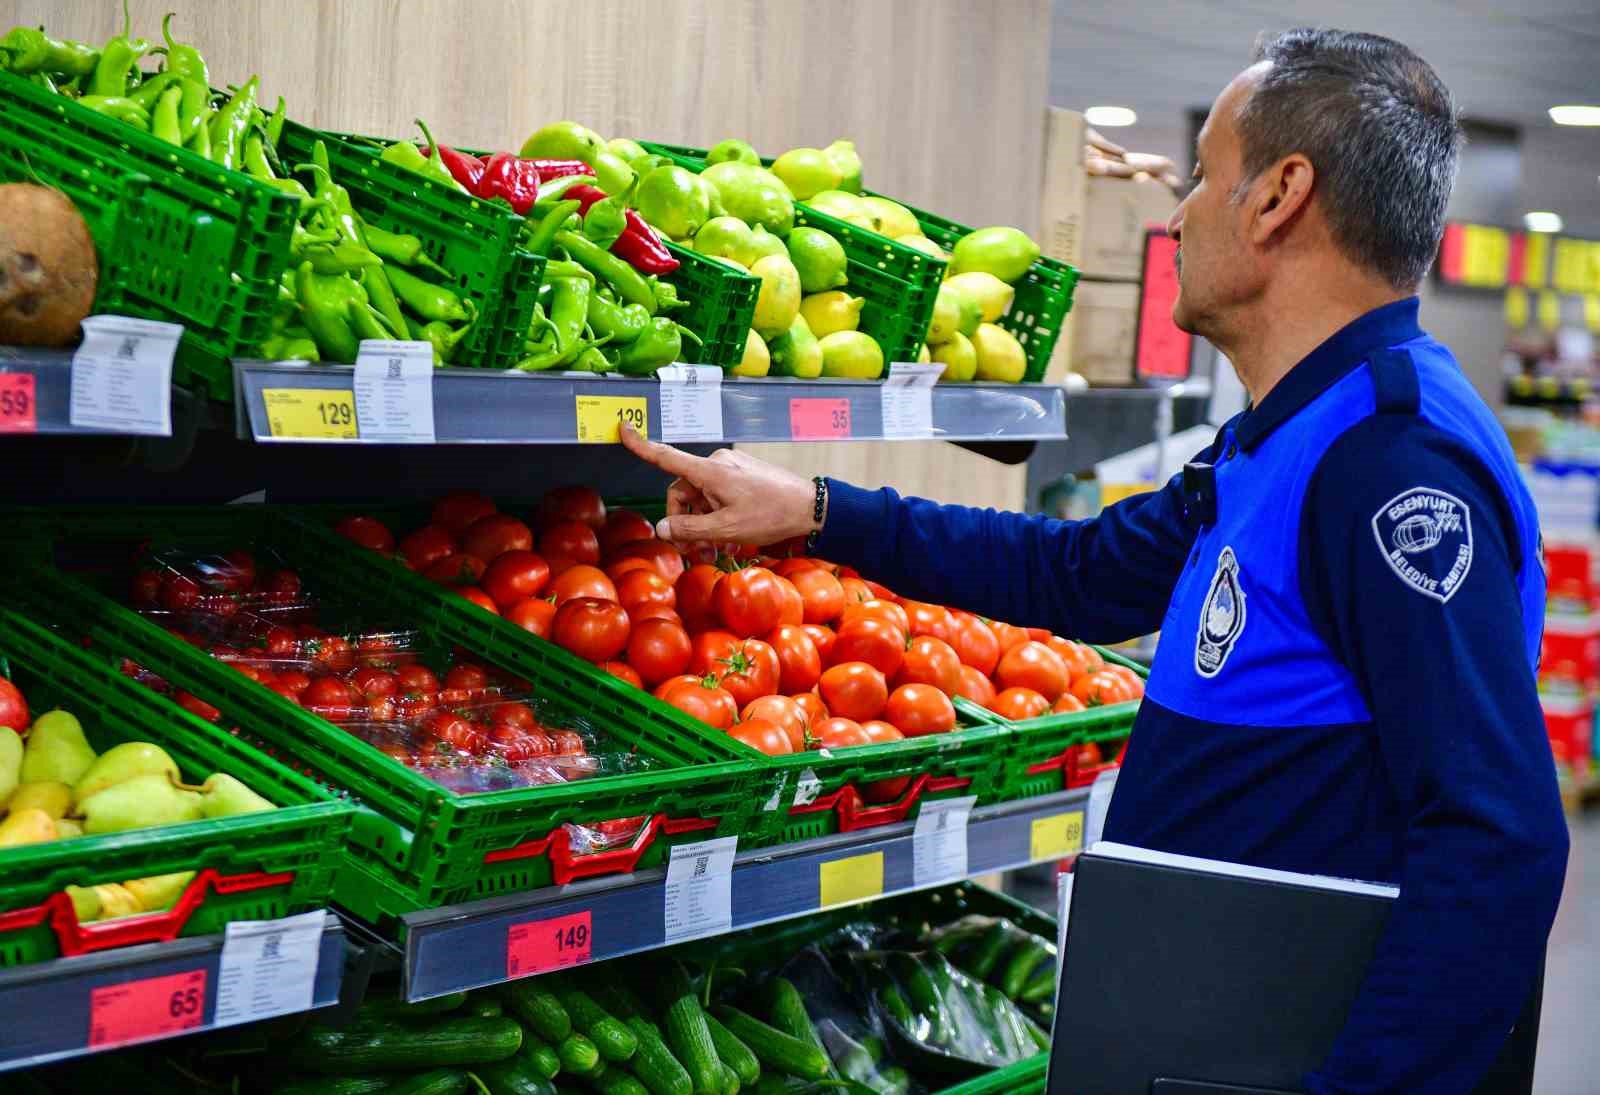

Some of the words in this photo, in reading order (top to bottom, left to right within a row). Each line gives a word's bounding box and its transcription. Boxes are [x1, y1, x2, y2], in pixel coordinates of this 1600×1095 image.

[1, 389, 28, 416] 59
[317, 402, 351, 425] 129
[617, 407, 643, 428] 129
[831, 410, 848, 429] 35
[1388, 495, 1456, 520] ESENYURT
[555, 924, 587, 952] 149
[170, 988, 198, 1018] 65
